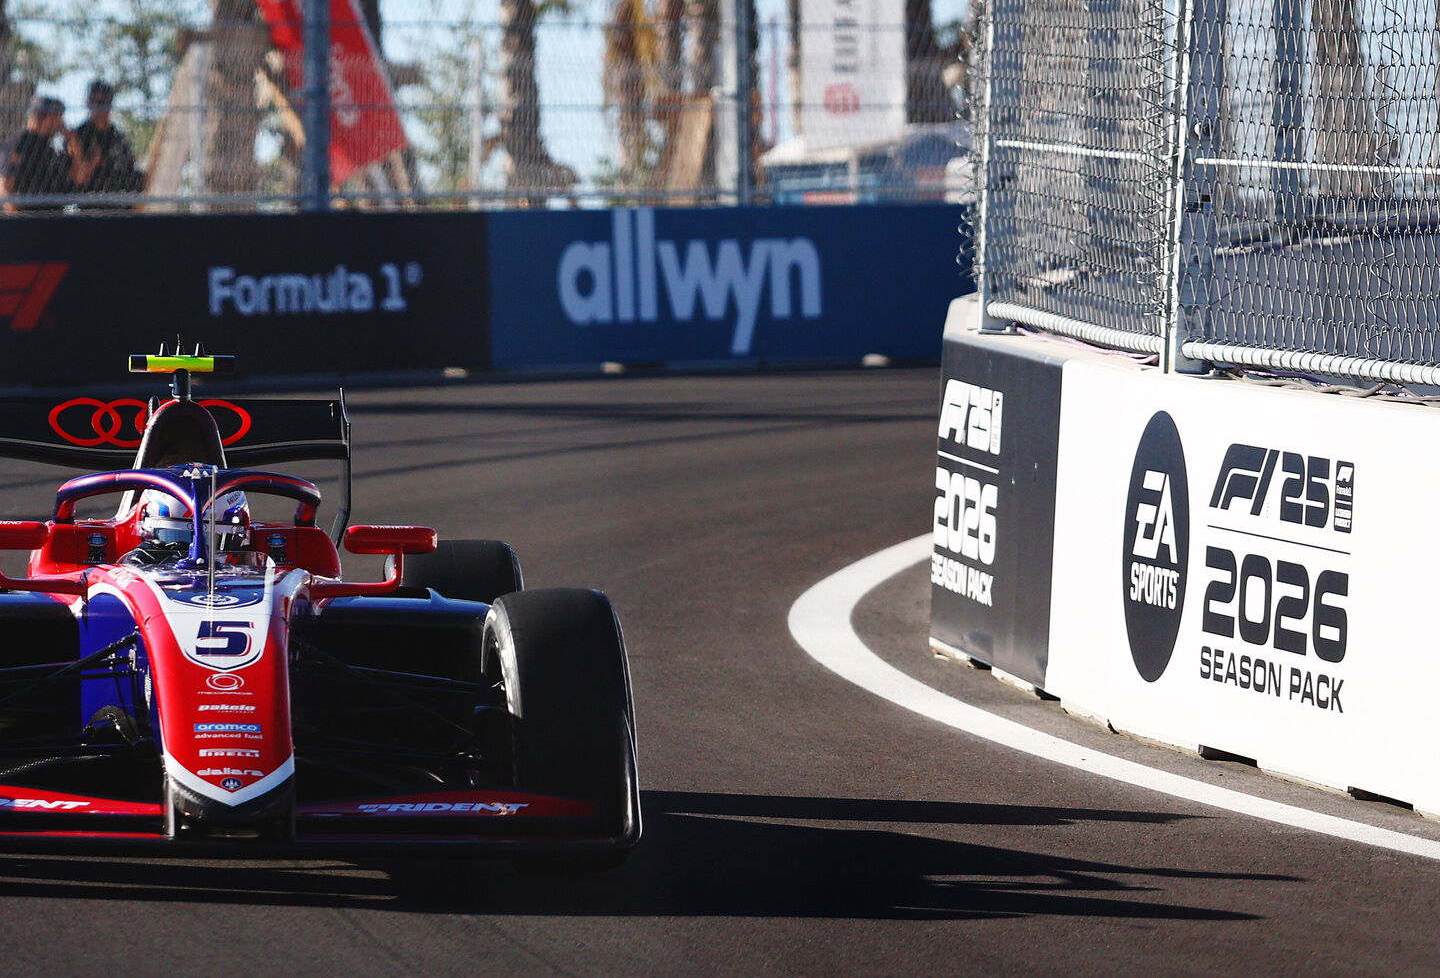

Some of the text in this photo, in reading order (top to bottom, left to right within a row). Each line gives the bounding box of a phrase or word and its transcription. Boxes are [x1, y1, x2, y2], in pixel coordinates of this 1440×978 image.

[208, 265, 374, 316] Formula
[557, 206, 822, 355] allwyn
[1280, 451, 1330, 529] 25
[933, 466, 999, 566] 2026
[1132, 469, 1178, 564] EA
[930, 552, 994, 607] SEASON PACK
[1130, 561, 1179, 610] SPORTS
[1202, 545, 1349, 664] 2026
[195, 621, 255, 658] 5
[1200, 645, 1345, 714] SEASON PACK
[197, 704, 257, 712] pakelo
[197, 723, 258, 731] aramco
[198, 748, 260, 757] PIRELLI
[244, 732, 263, 740] fuel
[196, 767, 265, 777] dallara
[357, 802, 529, 814] TRIDENT
